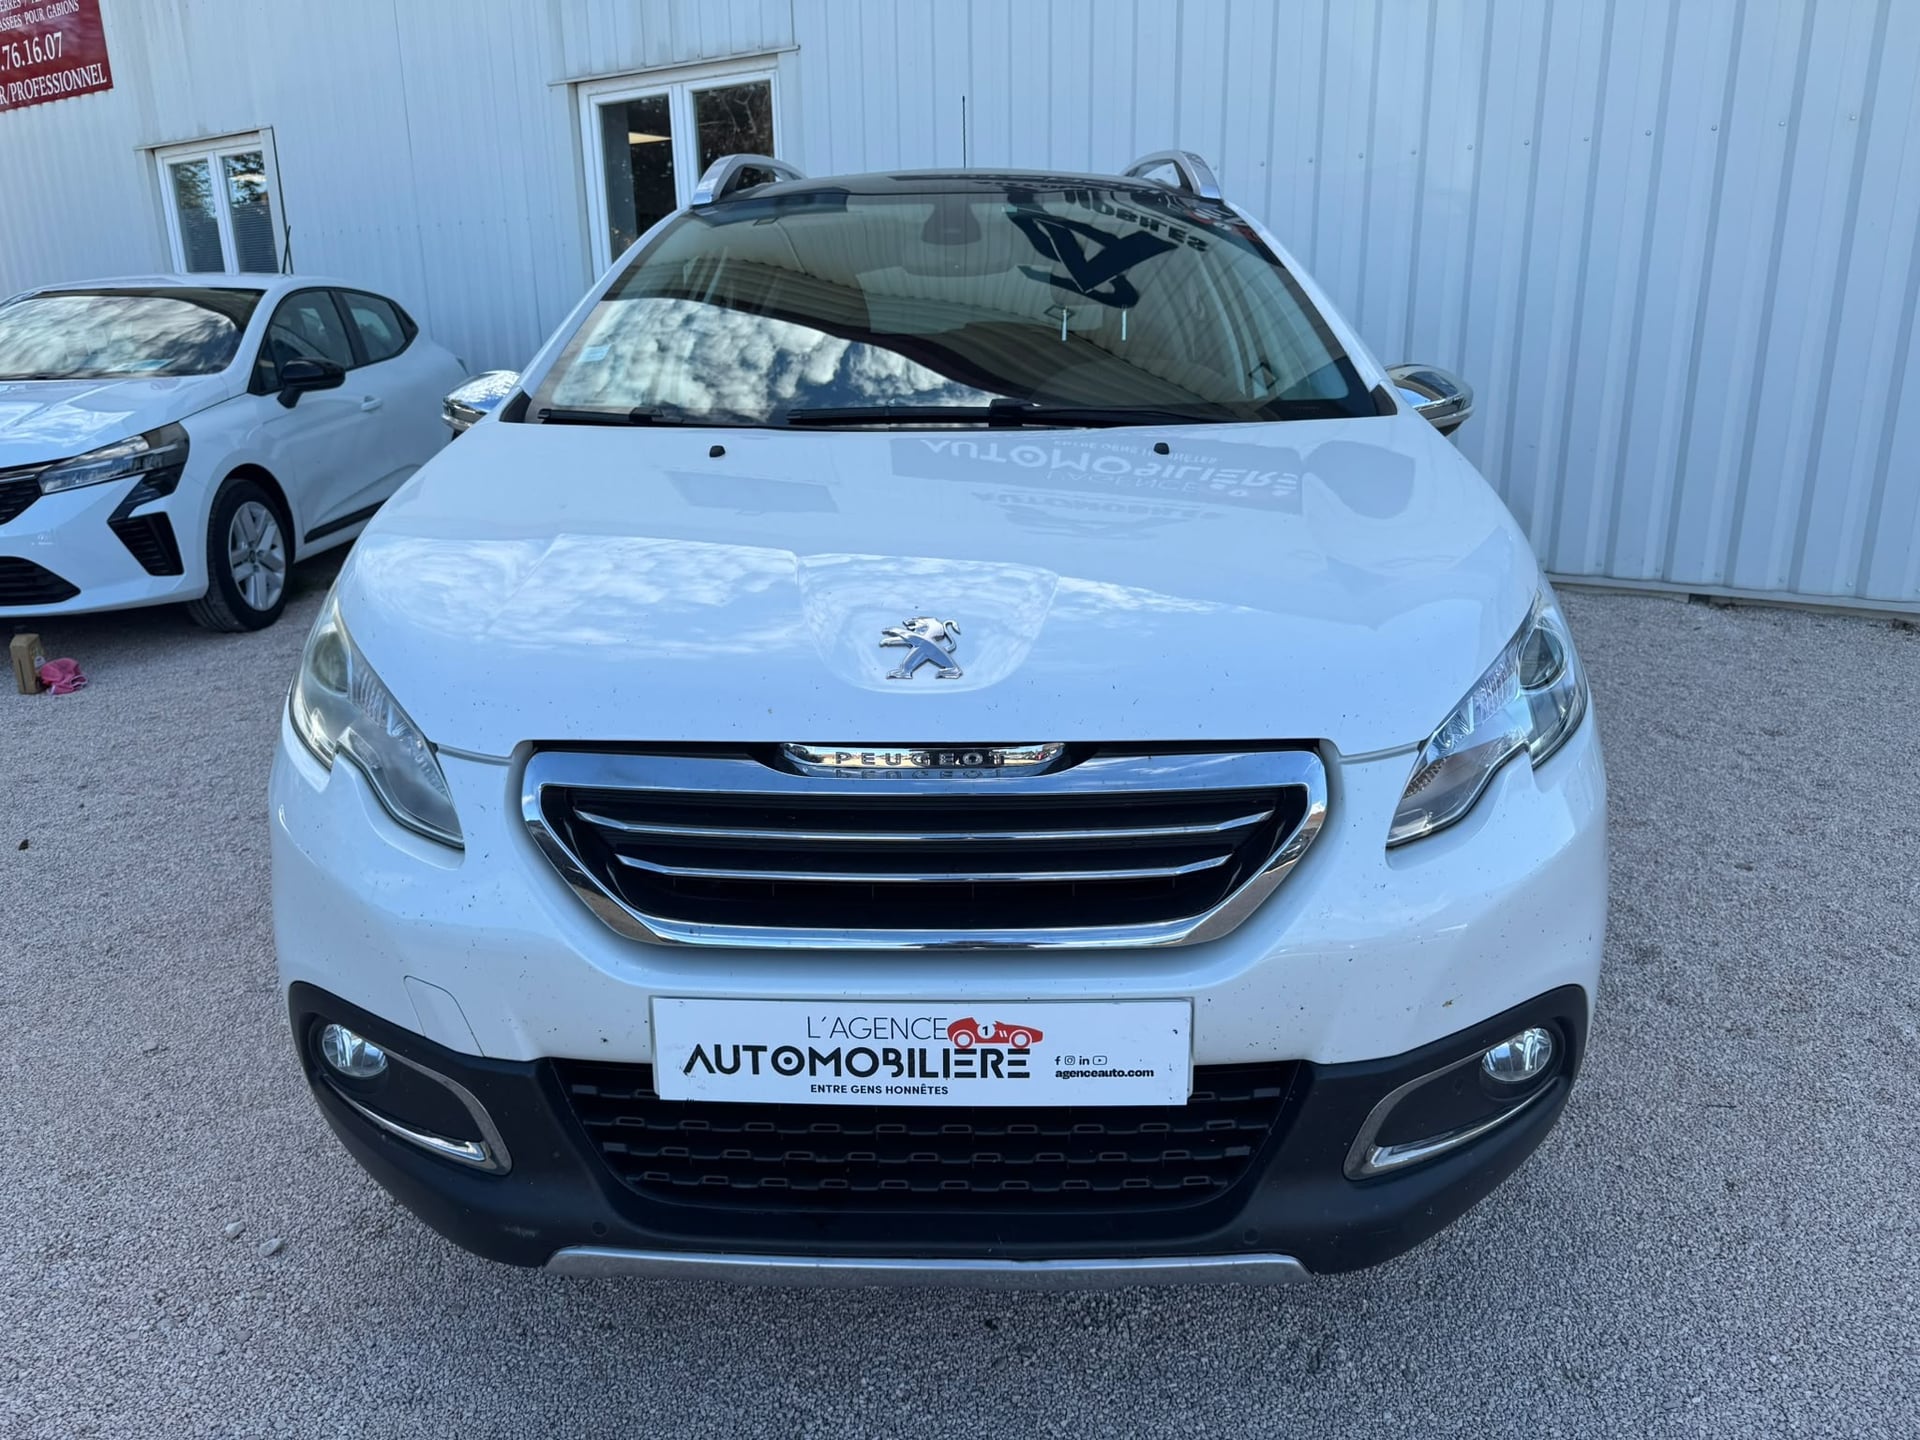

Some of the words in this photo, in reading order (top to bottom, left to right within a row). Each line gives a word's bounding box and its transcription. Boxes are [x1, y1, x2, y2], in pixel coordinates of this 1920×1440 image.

[24, 8, 45, 24] POUR
[46, 0, 79, 19] GABIONS
[0, 63, 107, 105] R/PROFESSIONNEL
[835, 751, 1004, 765] PEUGEOT
[807, 1016, 948, 1040] L'AGENCE
[982, 1026, 988, 1036] 1
[683, 1043, 1031, 1079] AUTOMOBILIERE
[1055, 1069, 1154, 1080] agenceauto.com
[810, 1084, 847, 1094] ENTRE
[850, 1085, 882, 1095] GENS
[885, 1083, 949, 1095] HONNÊTES
